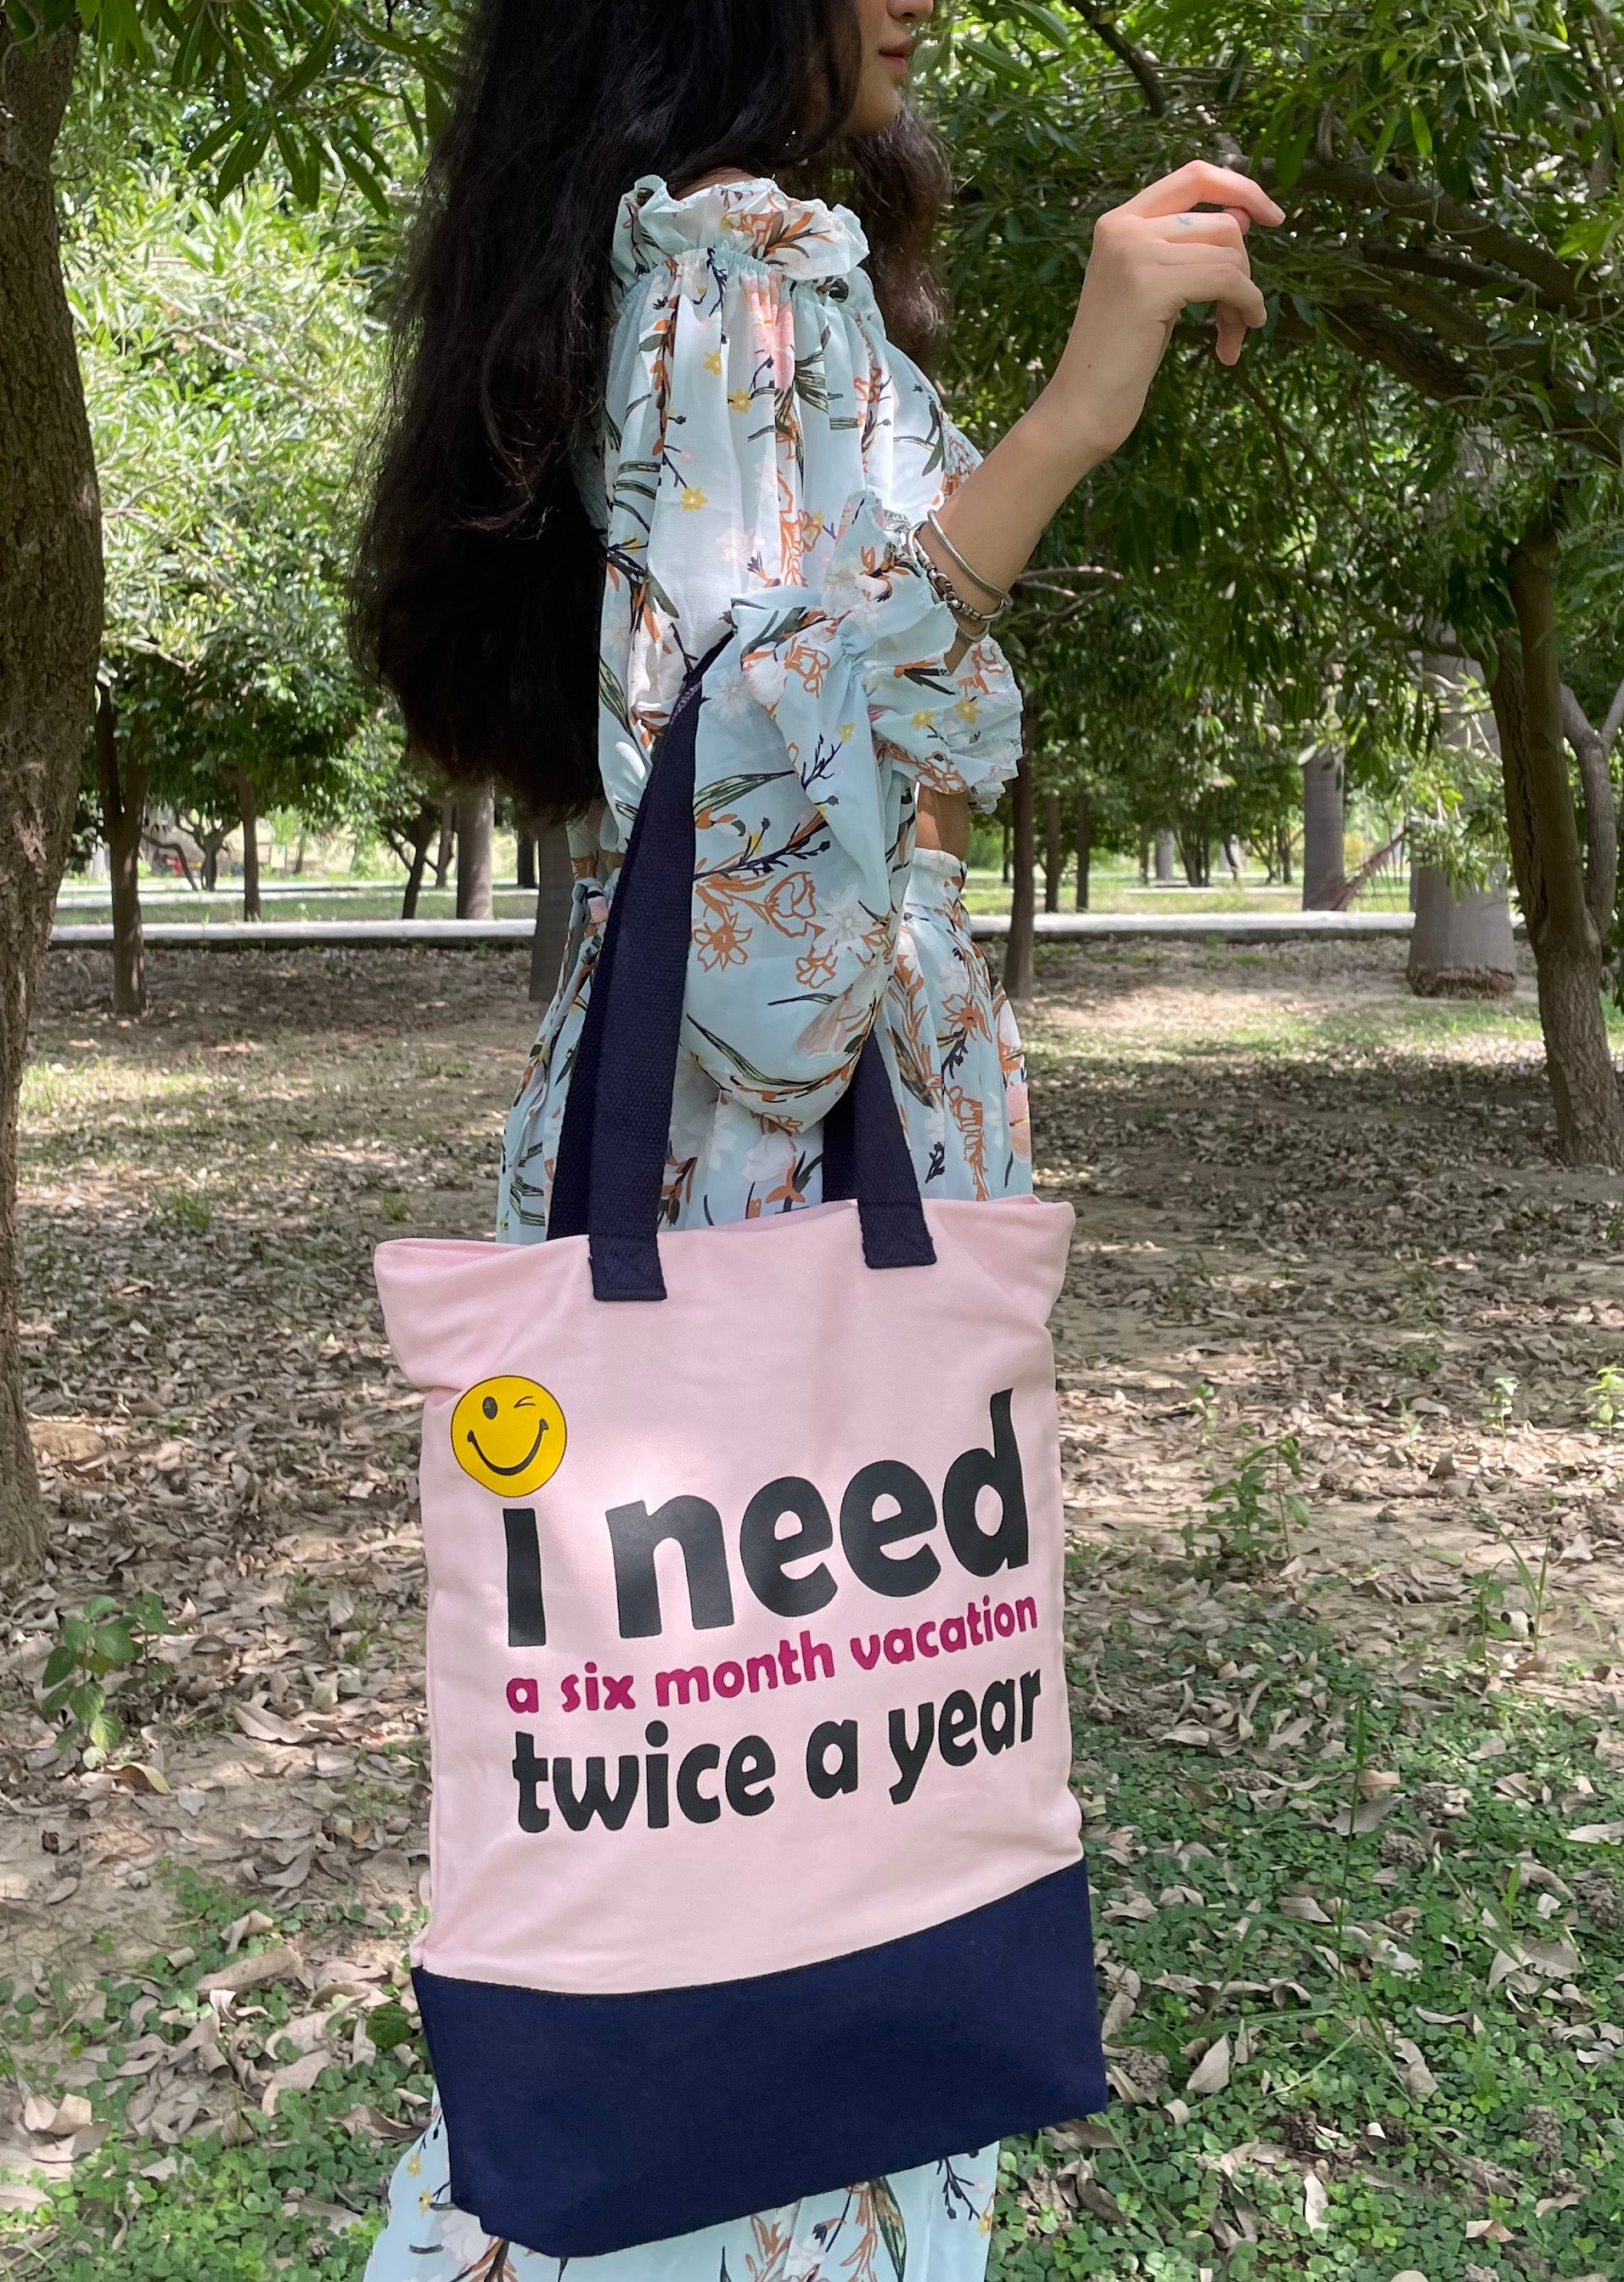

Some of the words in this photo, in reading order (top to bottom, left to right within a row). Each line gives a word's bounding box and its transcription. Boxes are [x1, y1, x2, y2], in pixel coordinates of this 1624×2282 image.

[606, 1387, 1030, 1639] need
[506, 1677, 539, 1713] a
[560, 1661, 636, 1712] six
[655, 1630, 835, 1707] month
[850, 1596, 1037, 1670] vacation
[512, 1721, 775, 1833] twice
[806, 1720, 857, 1799] a
[889, 1669, 1041, 1805] year
